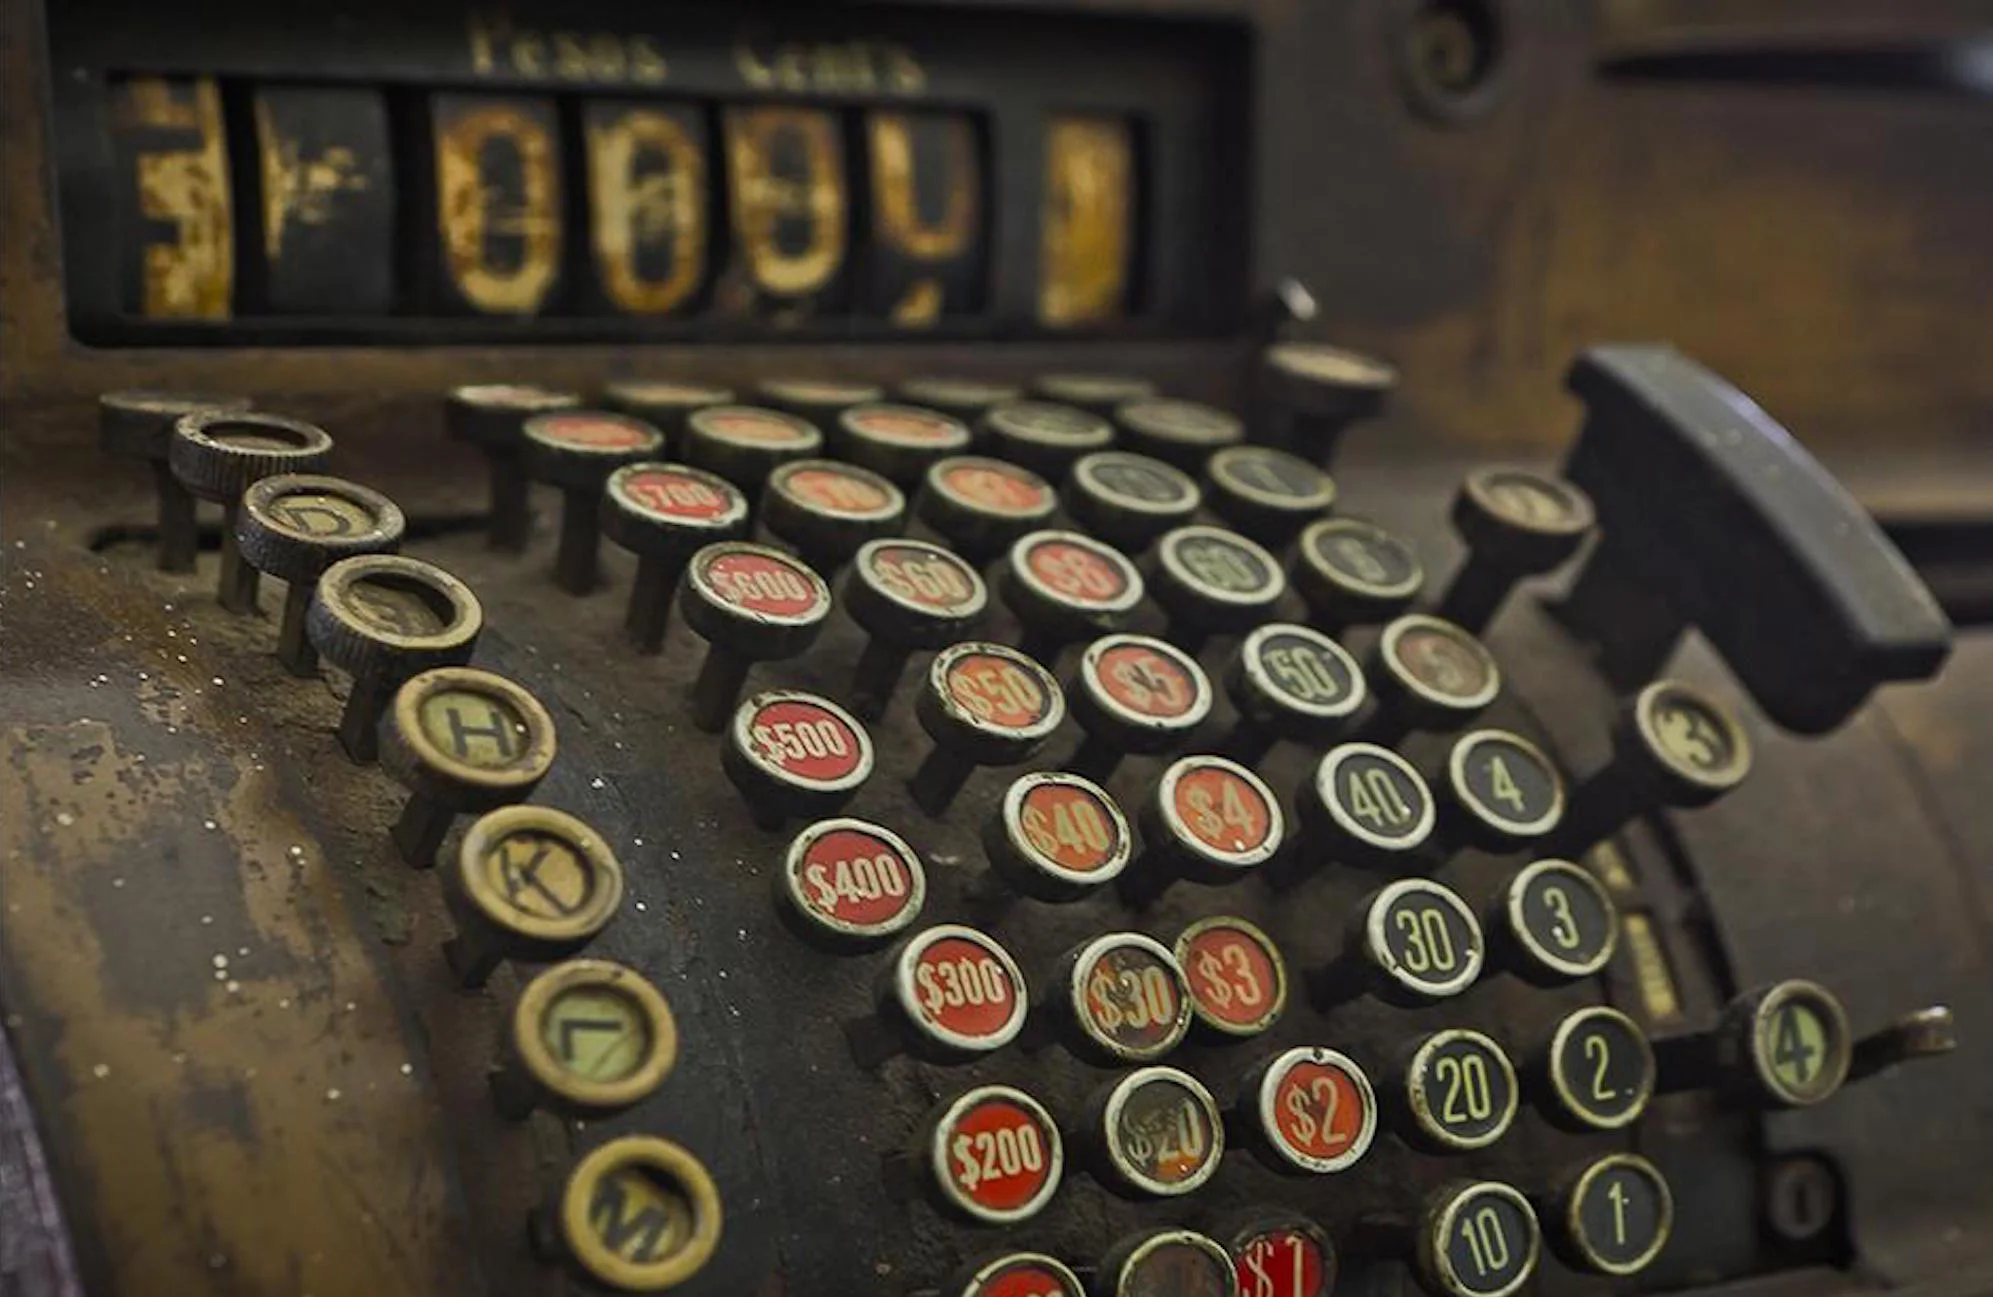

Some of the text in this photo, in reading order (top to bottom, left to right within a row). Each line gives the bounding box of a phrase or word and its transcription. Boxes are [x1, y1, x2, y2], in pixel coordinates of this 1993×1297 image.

[708, 568, 808, 604] $600
[872, 555, 973, 600] $60
[950, 664, 1043, 718] $50
[1112, 656, 1184, 709] $5
[1264, 646, 1338, 699] 50
[446, 706, 516, 758] H
[753, 719, 847, 766] $500
[1655, 708, 1717, 767] 3
[1186, 779, 1256, 841] $4
[1347, 768, 1407, 827] 40
[1485, 757, 1526, 812] 4
[1022, 798, 1112, 860] $40
[501, 843, 574, 916] K
[804, 853, 907, 913] $400
[1395, 908, 1456, 974] 30
[1544, 887, 1580, 949] 3
[915, 957, 1002, 1016] $300
[1094, 963, 1174, 1035] $30
[1198, 943, 1263, 1011] $3
[1585, 1035, 1617, 1100] 2
[1775, 1003, 1819, 1085] 4
[1285, 1076, 1347, 1148] $2
[1436, 1053, 1494, 1124] 20
[953, 1122, 1043, 1192] $200
[1127, 1097, 1203, 1163] $20
[588, 1176, 670, 1262] M
[1460, 1207, 1510, 1277] 10
[1607, 1181, 1627, 1246] 1
[1241, 1234, 1305, 1296] $1
